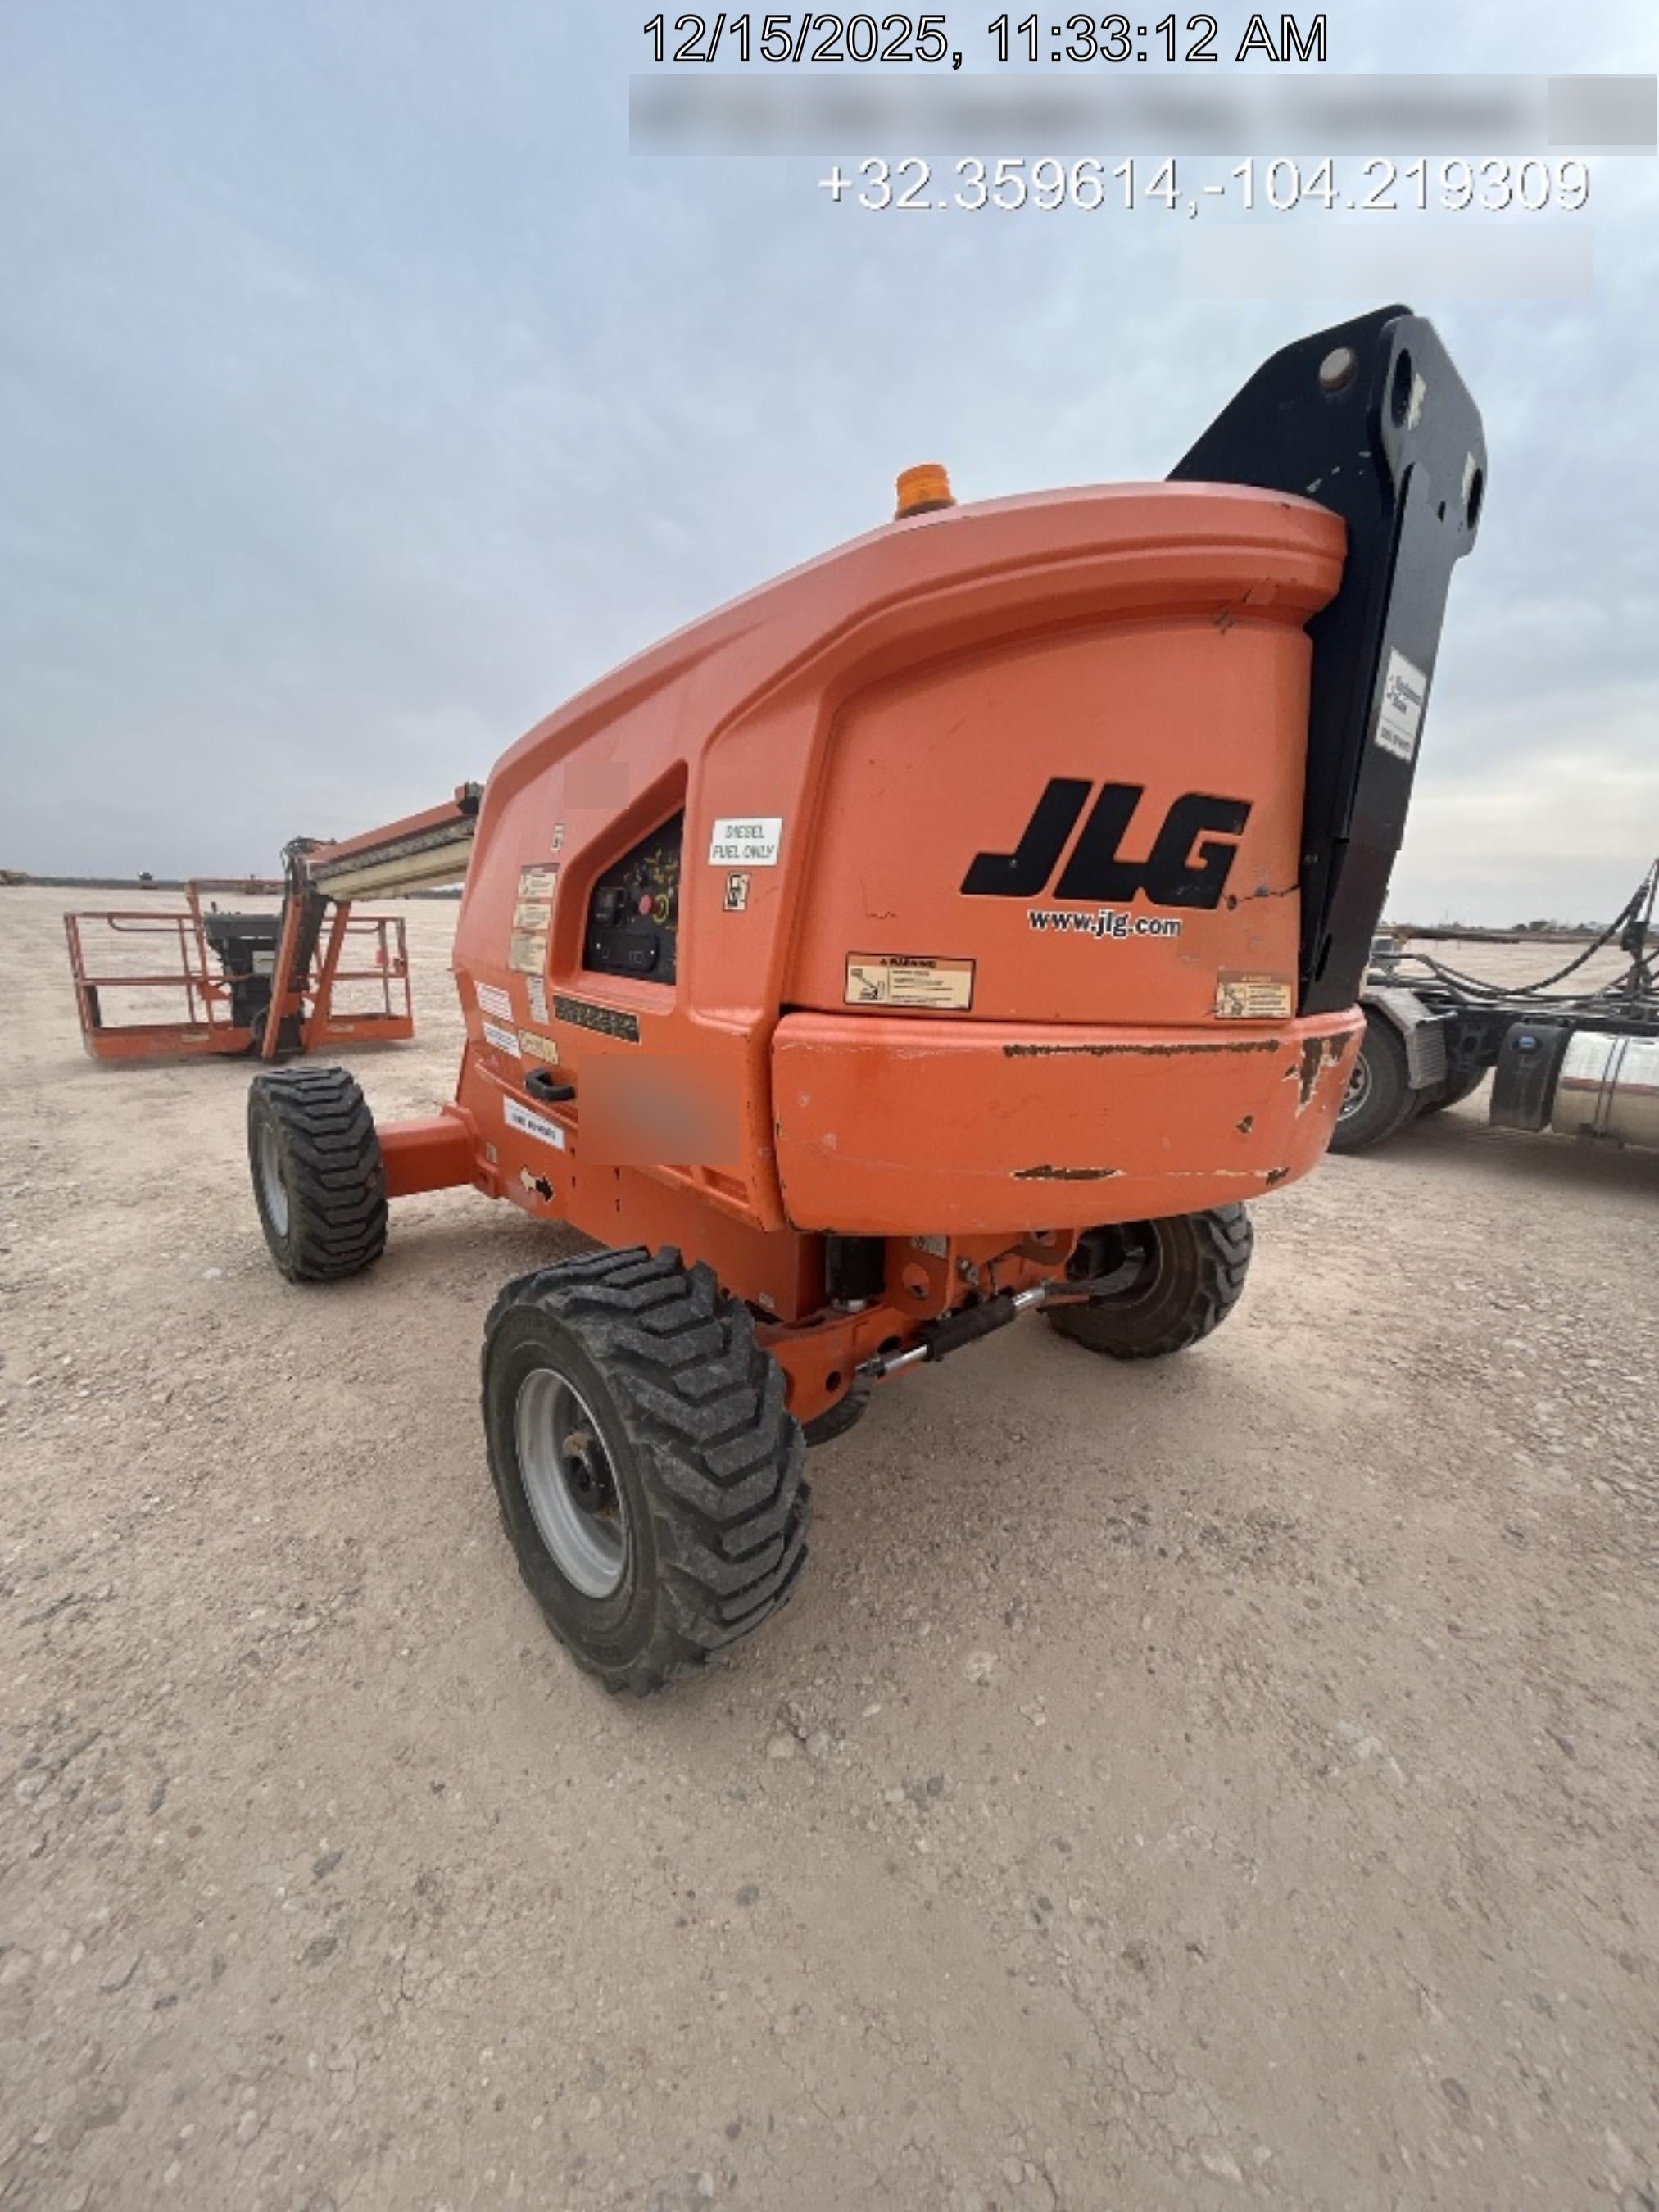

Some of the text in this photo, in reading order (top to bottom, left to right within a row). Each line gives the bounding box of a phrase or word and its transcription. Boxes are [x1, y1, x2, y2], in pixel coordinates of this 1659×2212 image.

[725, 825, 765, 839] DIESEL
[712, 845, 775, 859] FUEL ONLY
[959, 777, 1253, 910] JLG
[1027, 909, 1182, 940] www.jlg.com
